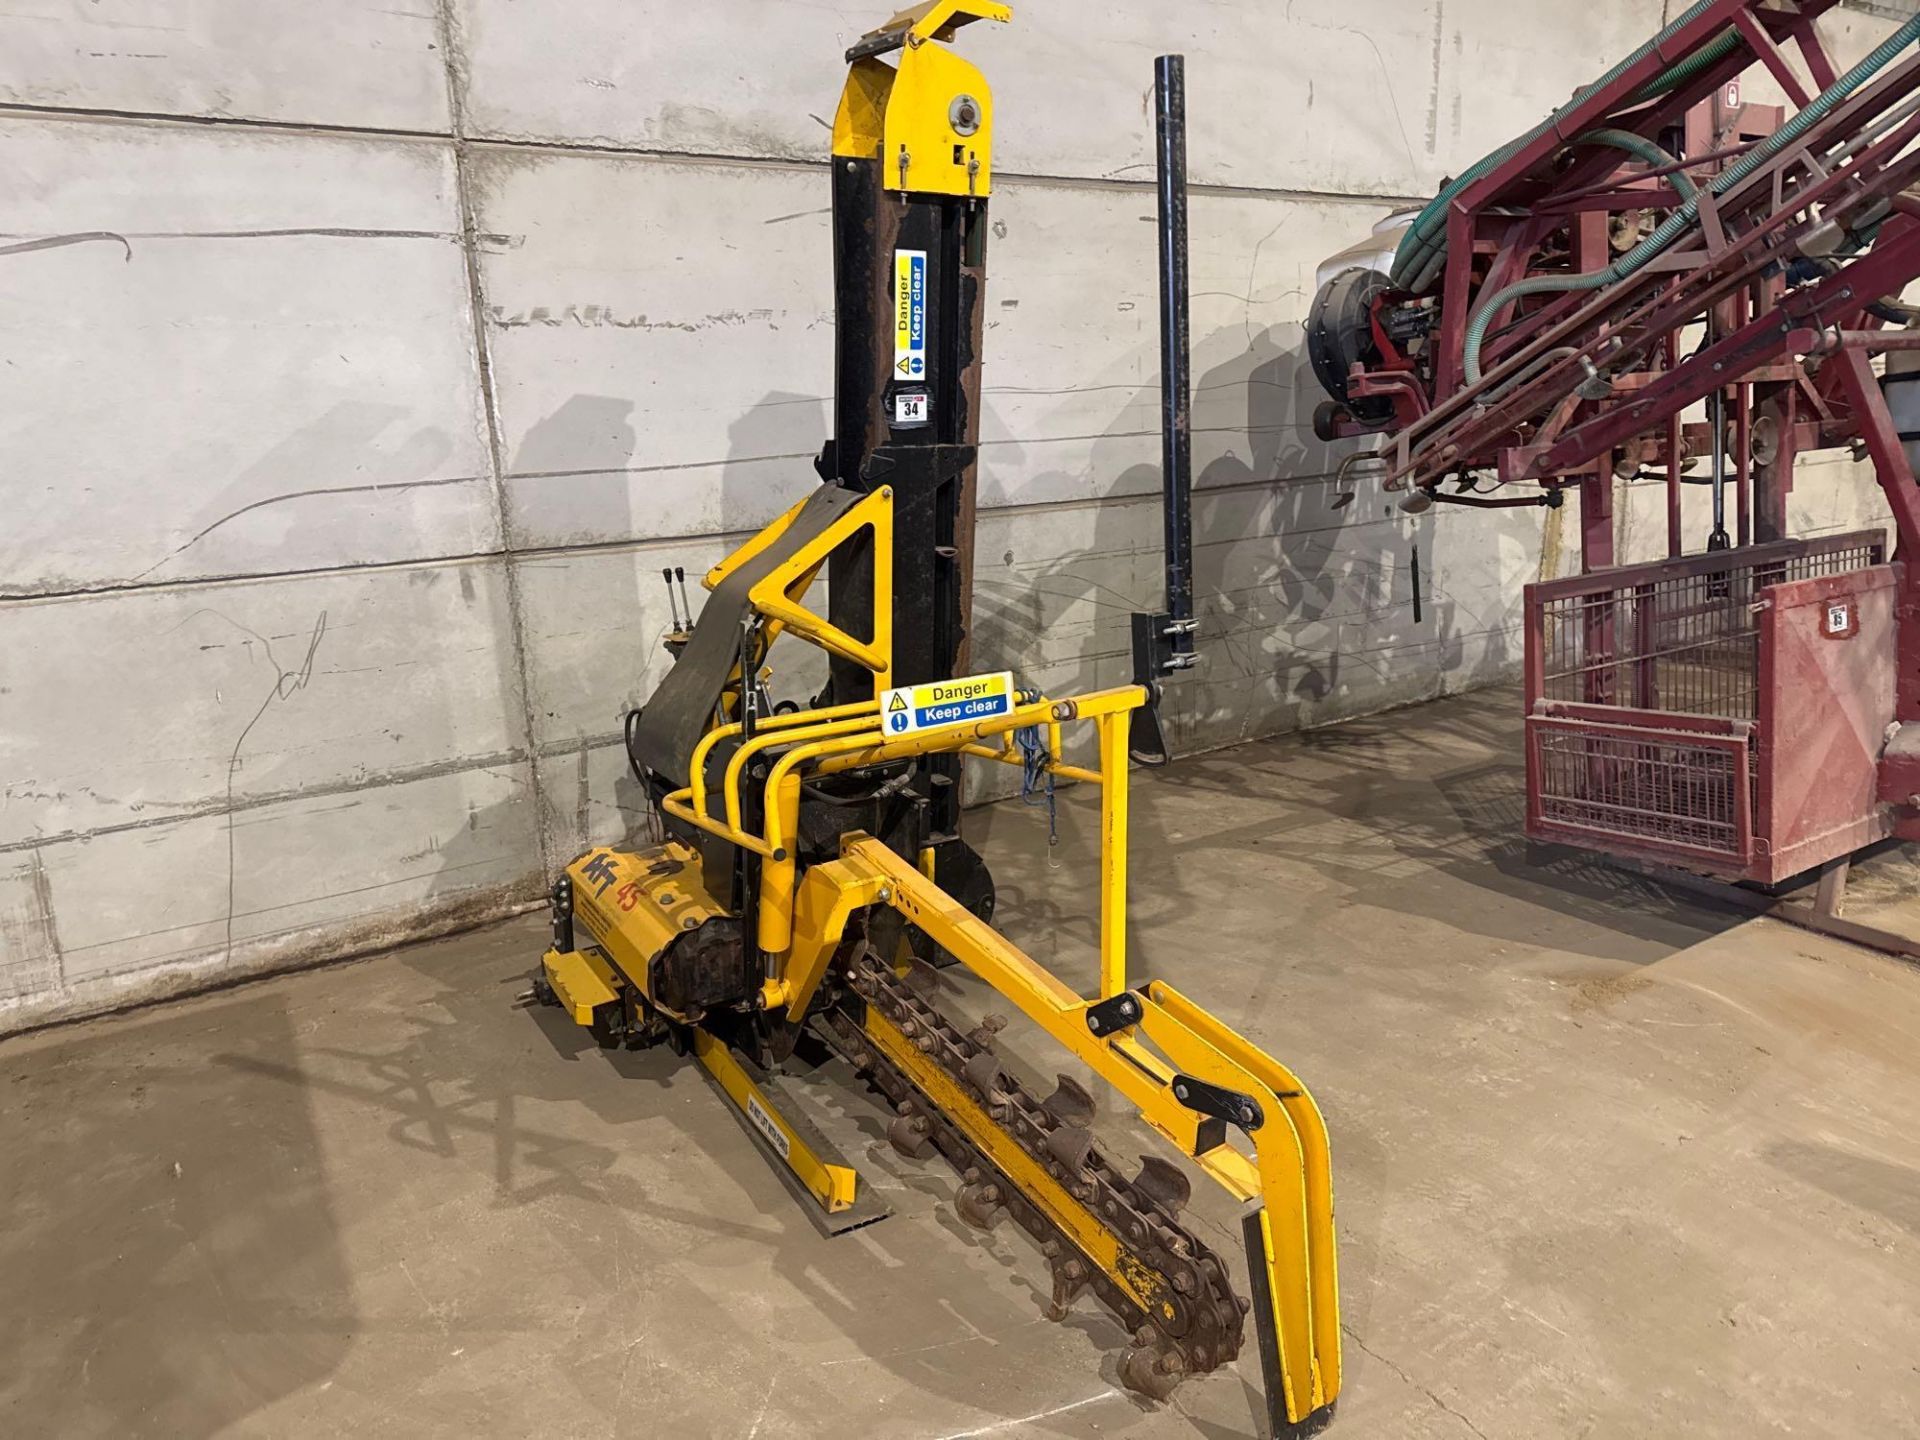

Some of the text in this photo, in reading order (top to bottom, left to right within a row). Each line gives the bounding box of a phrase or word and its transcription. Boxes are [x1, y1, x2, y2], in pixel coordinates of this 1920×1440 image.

[898, 274, 910, 331] Danger
[911, 265, 922, 341] Keep clear
[904, 402, 919, 416] 34
[1834, 613, 1842, 626] 85
[933, 682, 988, 701] Danger
[924, 699, 999, 722] Keep clear
[580, 853, 619, 900] AFT
[616, 881, 649, 912] 45
